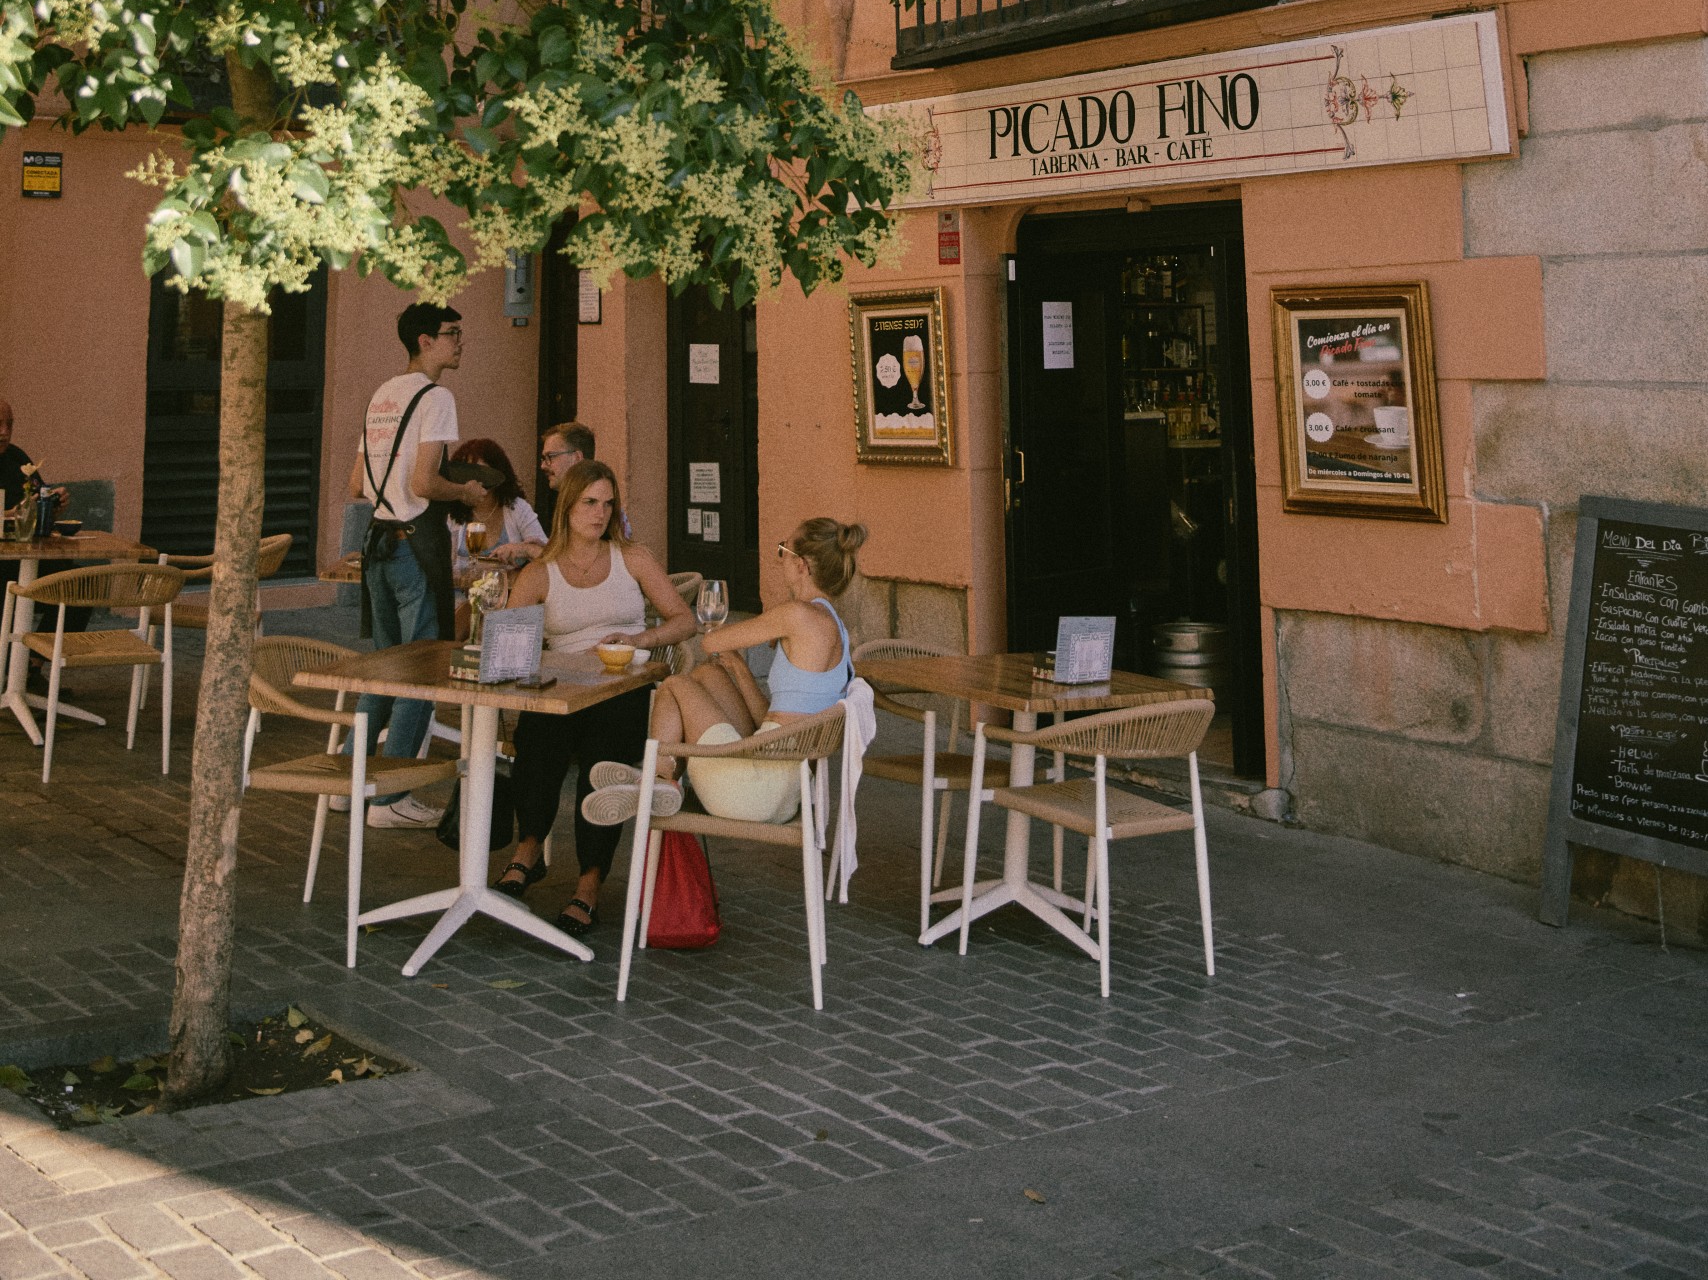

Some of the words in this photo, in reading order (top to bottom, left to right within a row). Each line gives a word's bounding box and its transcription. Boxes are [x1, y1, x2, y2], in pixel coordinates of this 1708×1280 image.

[988, 90, 1136, 160] PICADO
[1156, 72, 1260, 139] FINO
[1029, 153, 1100, 176] TABERNA
[1116, 144, 1151, 167] BAR
[1166, 131, 1213, 161] CAFÉ
[1307, 330, 1350, 348] Comienza
[1351, 324, 1362, 337] el
[1378, 322, 1391, 332] en
[1320, 340, 1353, 357] Picado
[1305, 380, 1320, 388] 3,00
[1332, 379, 1349, 387] Café
[1308, 424, 1323, 432] 3,00
[1335, 425, 1352, 433] Café
[1360, 426, 1395, 434] croissant
[1369, 454, 1398, 463] naranja
[1353, 470, 1383, 479] Domingos
